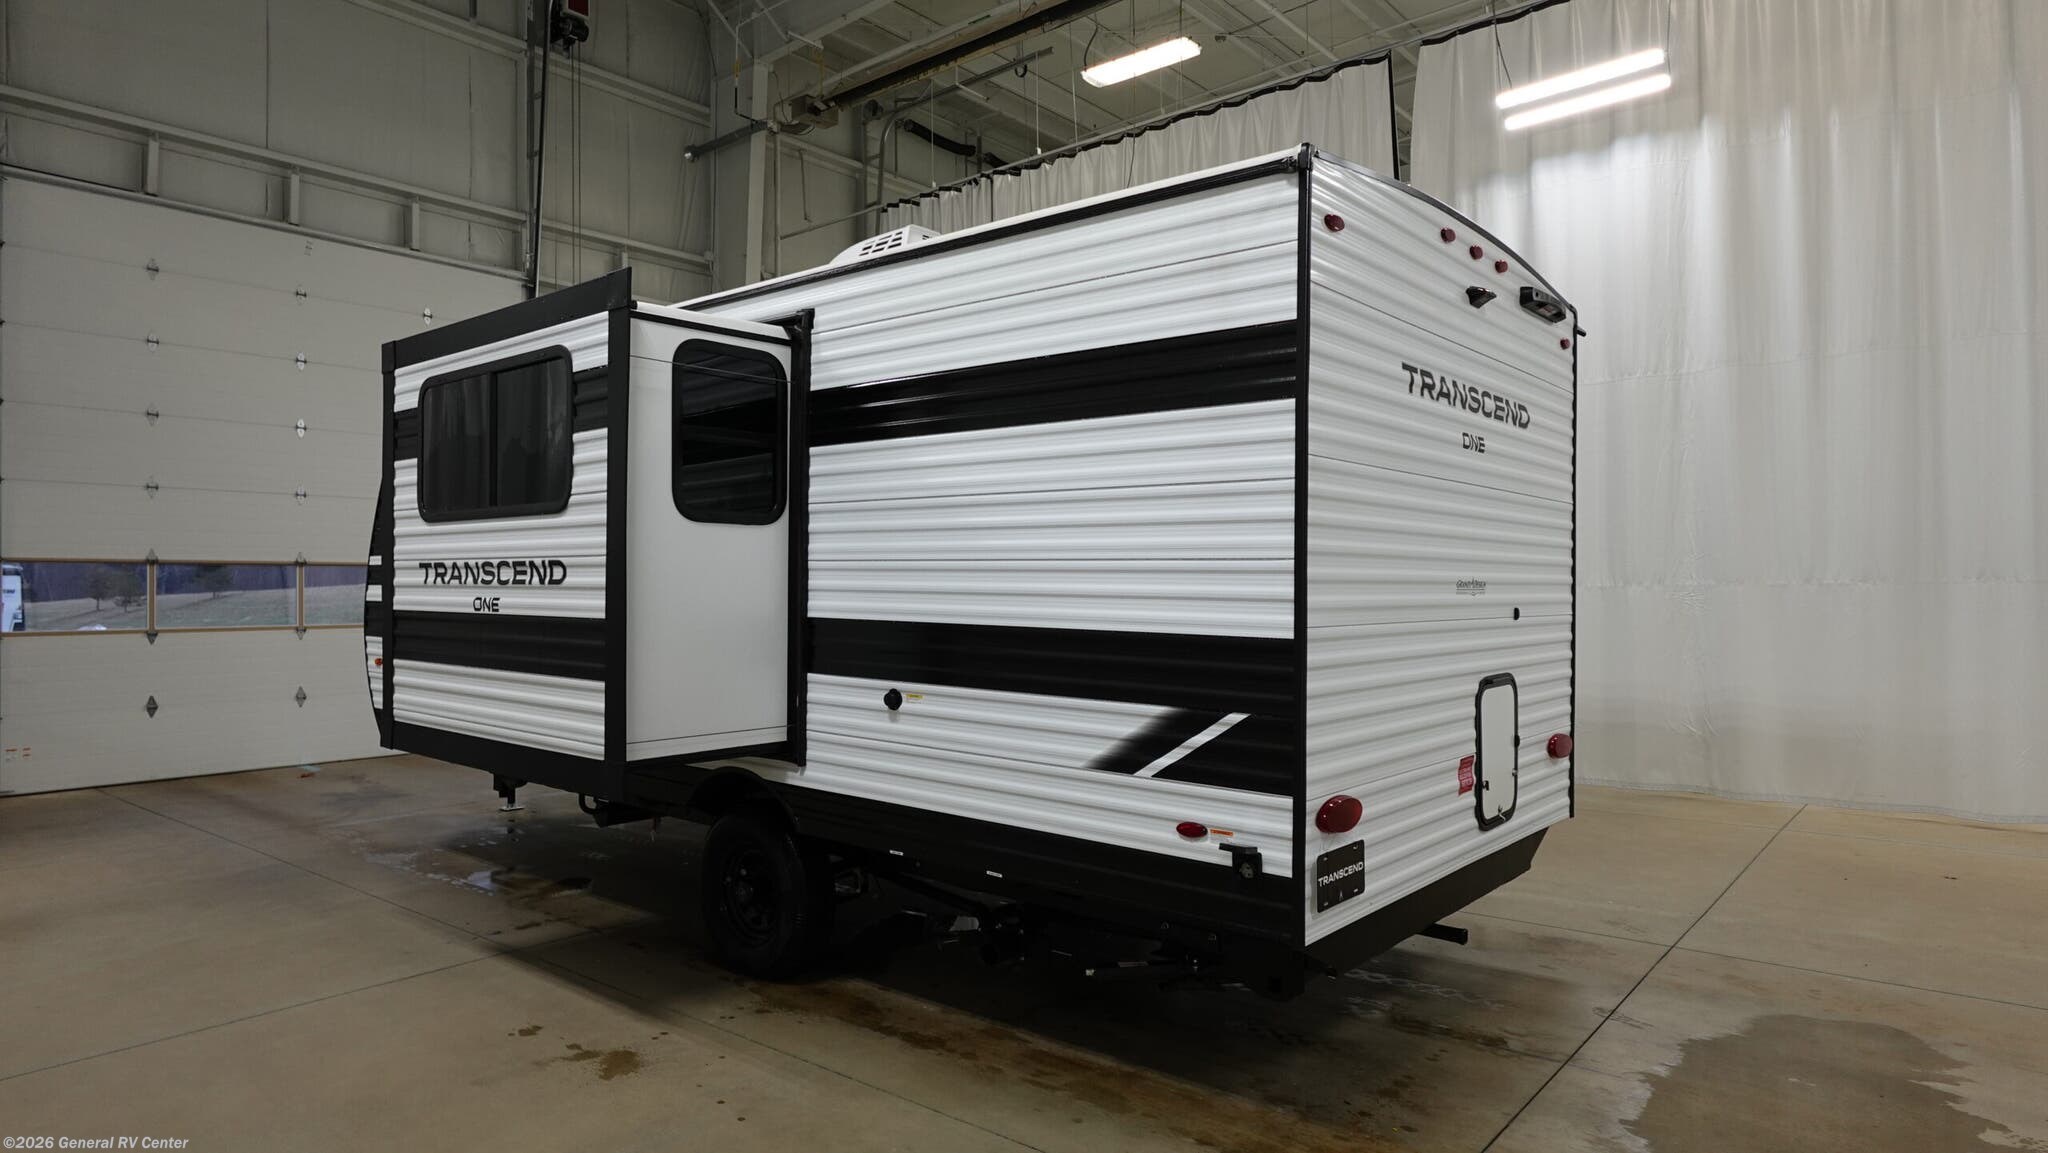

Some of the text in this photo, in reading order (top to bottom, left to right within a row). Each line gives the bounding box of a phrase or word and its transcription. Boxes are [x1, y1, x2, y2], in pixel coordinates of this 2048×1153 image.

[1401, 361, 1531, 430] TRANSCEND
[418, 559, 568, 586] TRANSCEND
[472, 597, 501, 613] ONE
[1317, 861, 1364, 888] TRANSCEND
